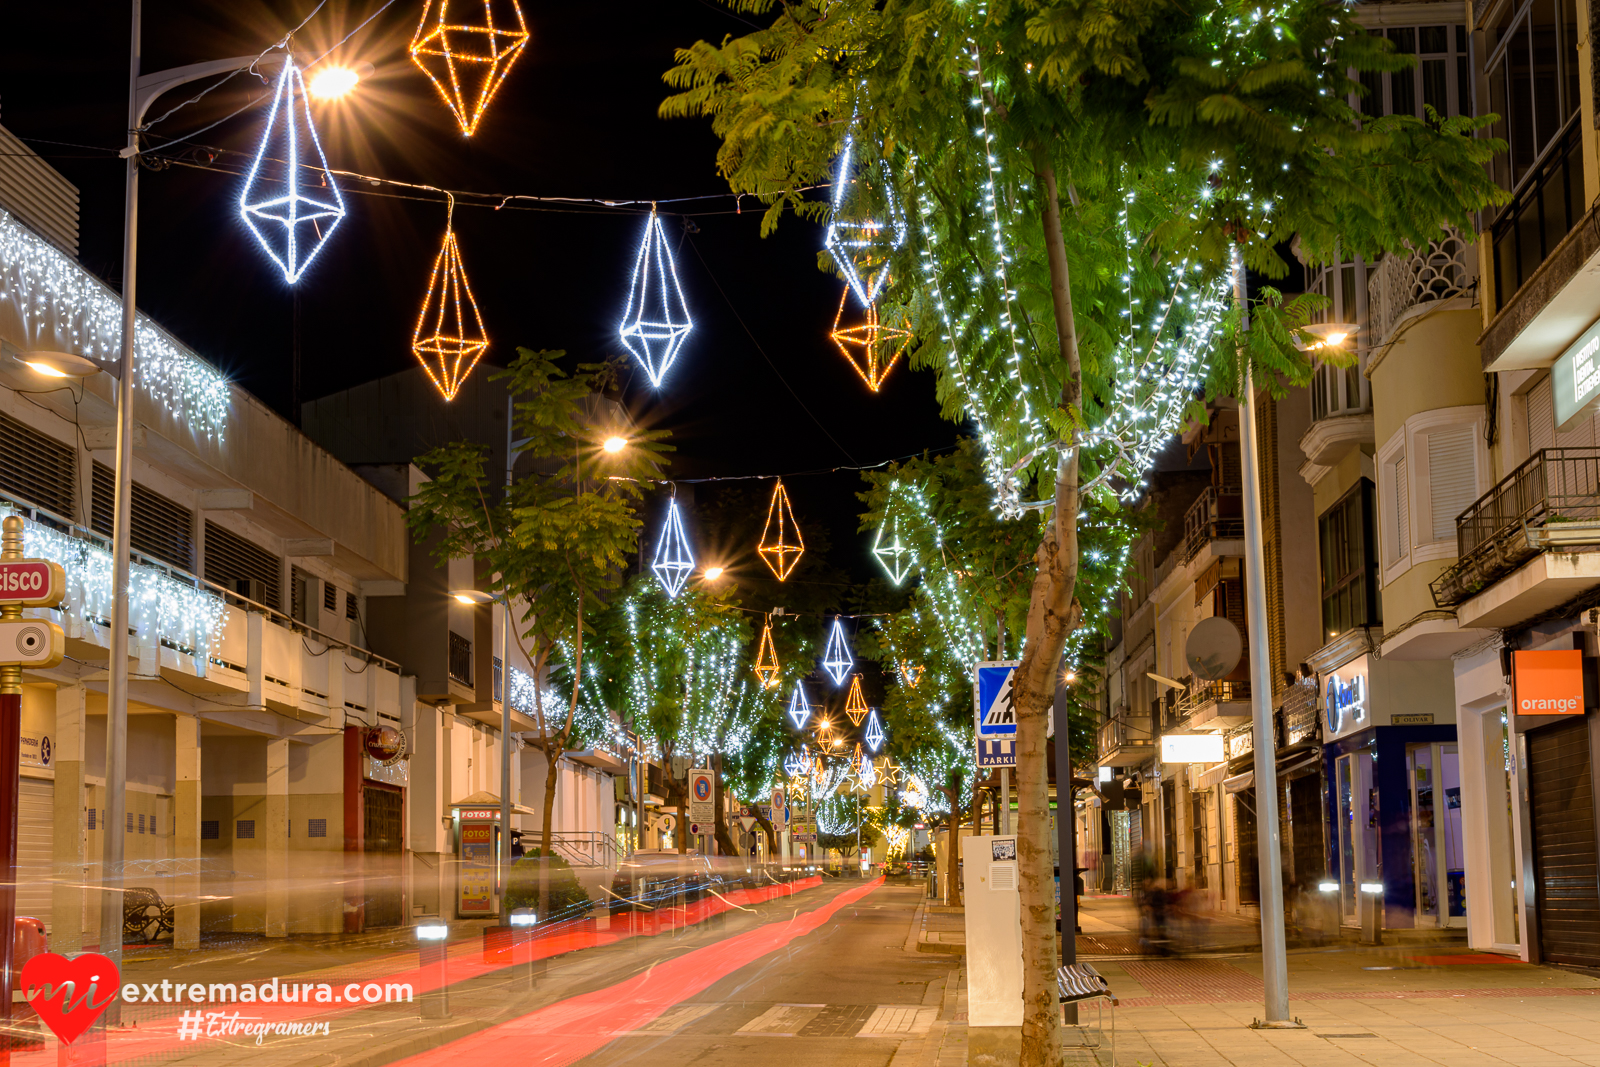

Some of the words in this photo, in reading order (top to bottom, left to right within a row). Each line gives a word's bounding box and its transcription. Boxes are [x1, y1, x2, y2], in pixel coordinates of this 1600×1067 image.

[1575, 336, 1599, 368] INSTITUTO
[1577, 358, 1595, 384] DENTAL
[1577, 365, 1600, 400] EXTREME
[0, 567, 42, 591] isco
[1521, 698, 1577, 713] orange
[983, 756, 1017, 765] PARKI
[463, 830, 490, 838] FOTOS
